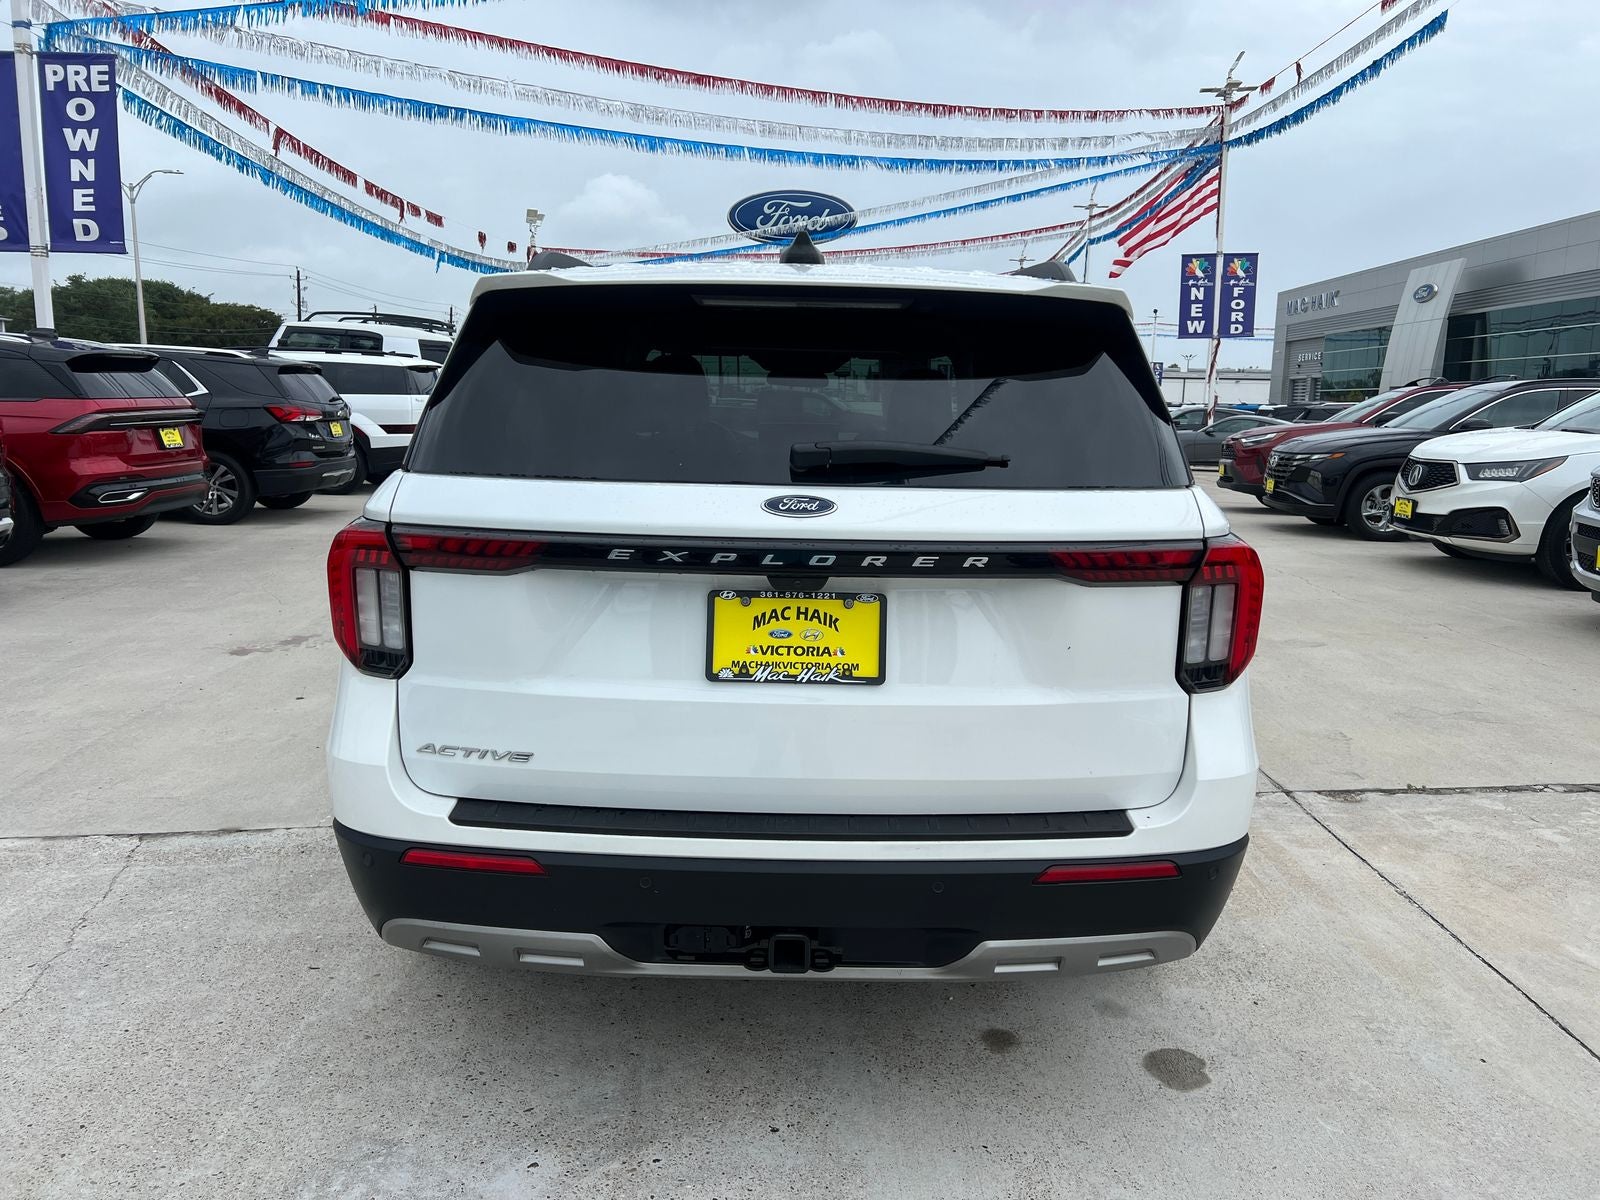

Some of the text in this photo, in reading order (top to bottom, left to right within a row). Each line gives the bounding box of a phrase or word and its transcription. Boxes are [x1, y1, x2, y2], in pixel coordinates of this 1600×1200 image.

[44, 64, 110, 92] PRE
[62, 97, 100, 242] OWNED
[756, 199, 830, 231] Ford
[1186, 287, 1206, 334] NEW
[1229, 287, 1246, 334] FORD
[1286, 290, 1340, 316] MAC HAIK
[1297, 351, 1322, 362] SERVICE
[778, 496, 820, 513] Ford
[606, 548, 989, 568] EXPLORER
[760, 591, 837, 600] 361-576-1221
[752, 606, 840, 633] MAC HAIK
[759, 645, 832, 657] VICTORIA
[751, 665, 841, 683] Mac Haik
[416, 743, 534, 763] ACTIVE
